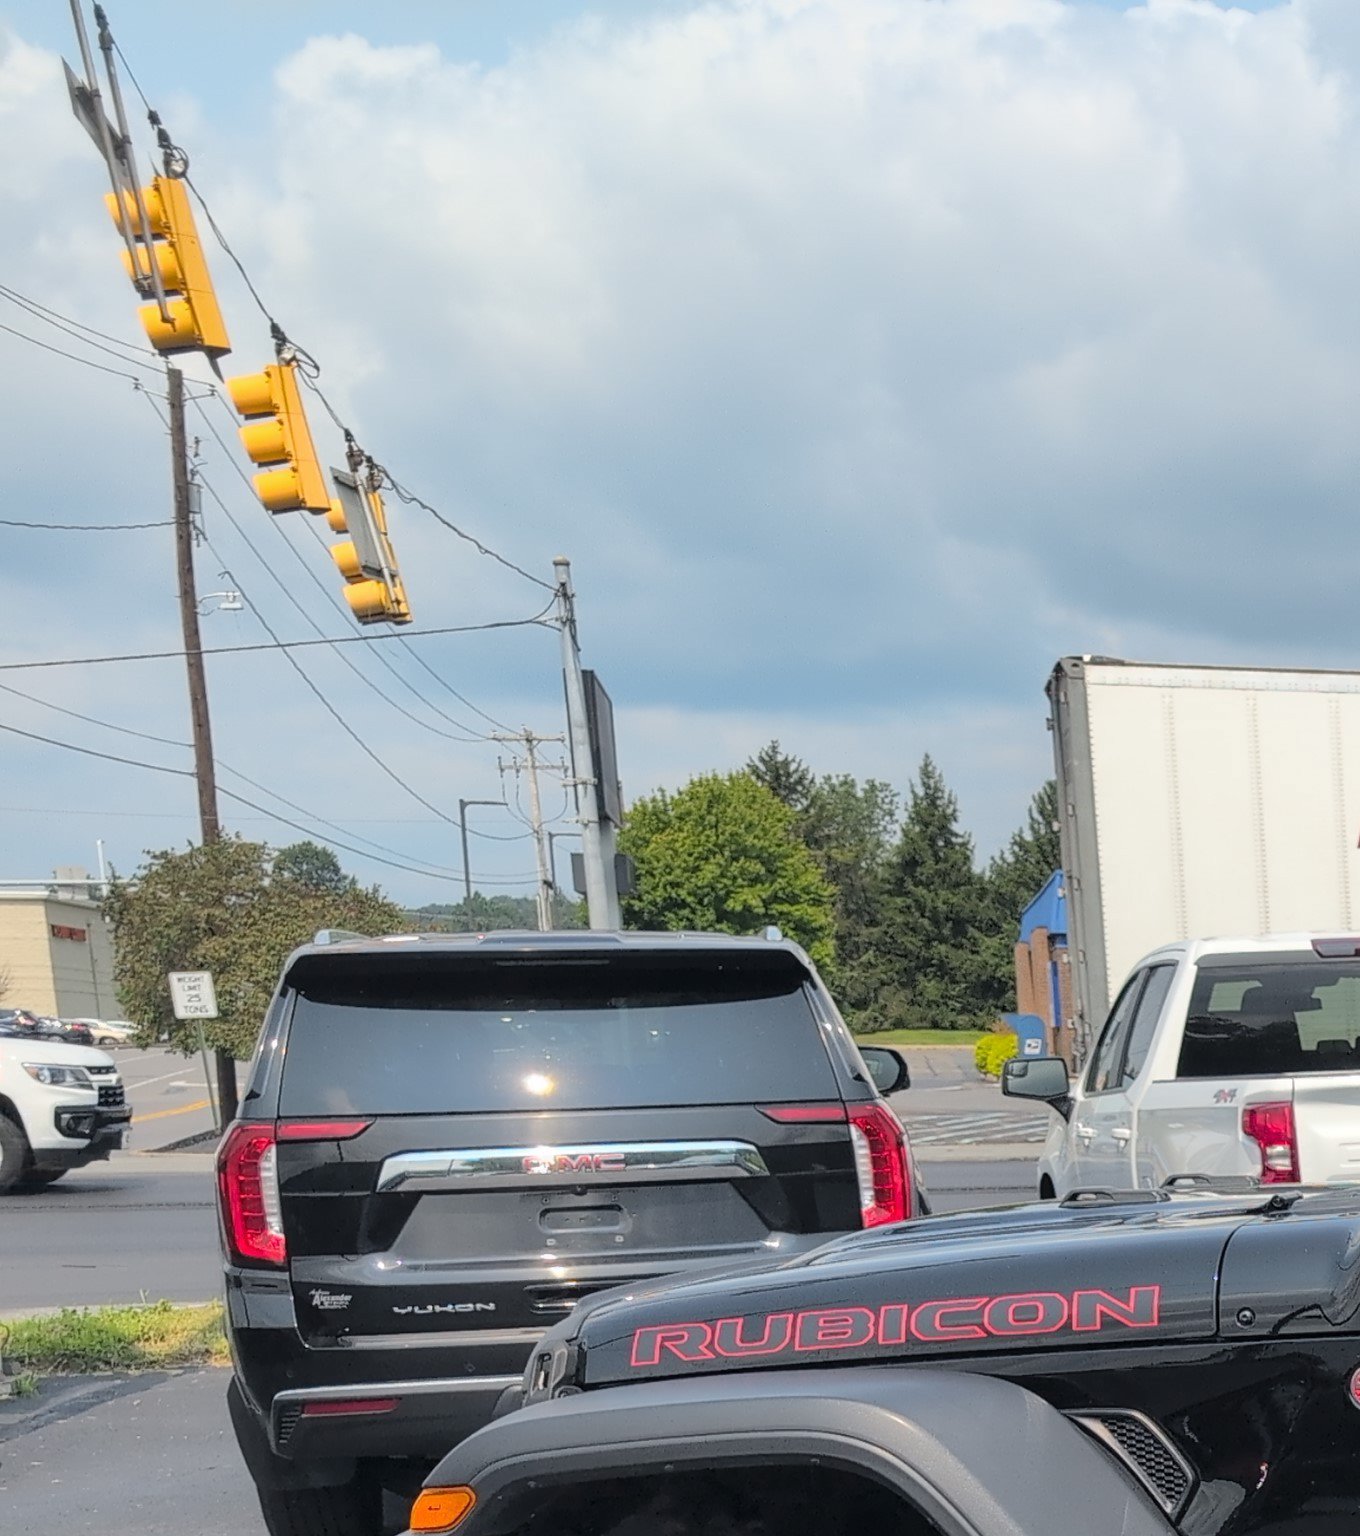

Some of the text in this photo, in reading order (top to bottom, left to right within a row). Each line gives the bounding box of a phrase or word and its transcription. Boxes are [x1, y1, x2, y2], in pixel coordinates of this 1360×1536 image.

[186, 994, 202, 1002] 25
[522, 1153, 626, 1175] GMC
[392, 1302, 496, 1315] YUKON
[631, 1285, 1161, 1367] RUBICON
